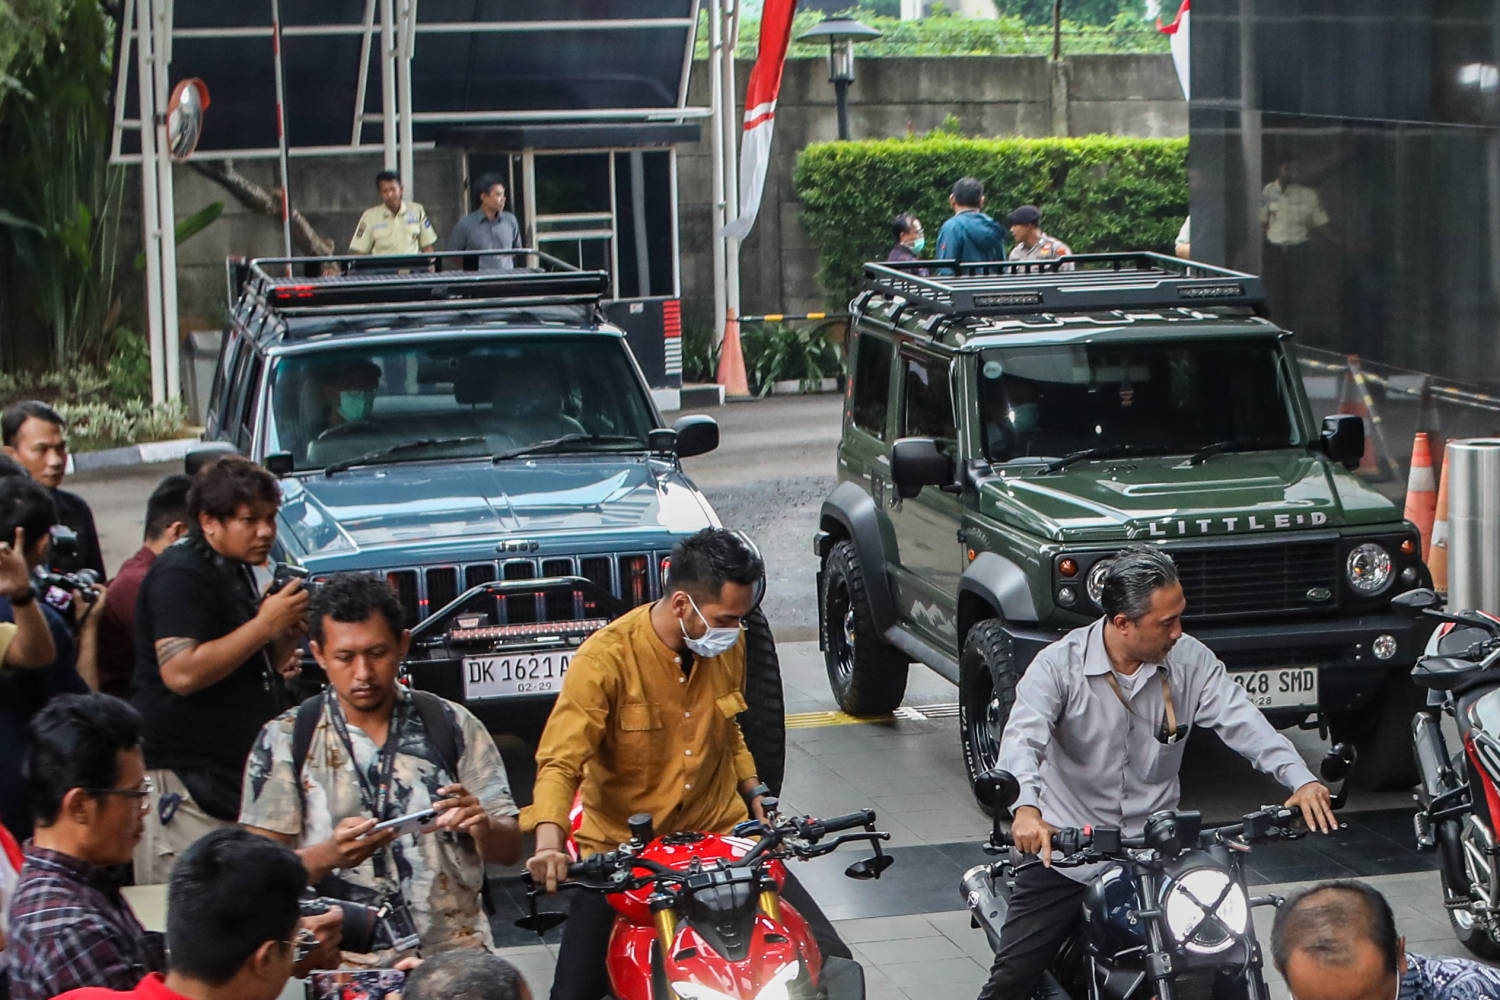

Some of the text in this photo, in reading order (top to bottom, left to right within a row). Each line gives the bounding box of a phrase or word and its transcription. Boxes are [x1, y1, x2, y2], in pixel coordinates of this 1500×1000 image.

[495, 540, 539, 553] Jeep
[469, 661, 495, 683] DK
[501, 656, 555, 681] 1621
[1279, 671, 1314, 692] SMD
